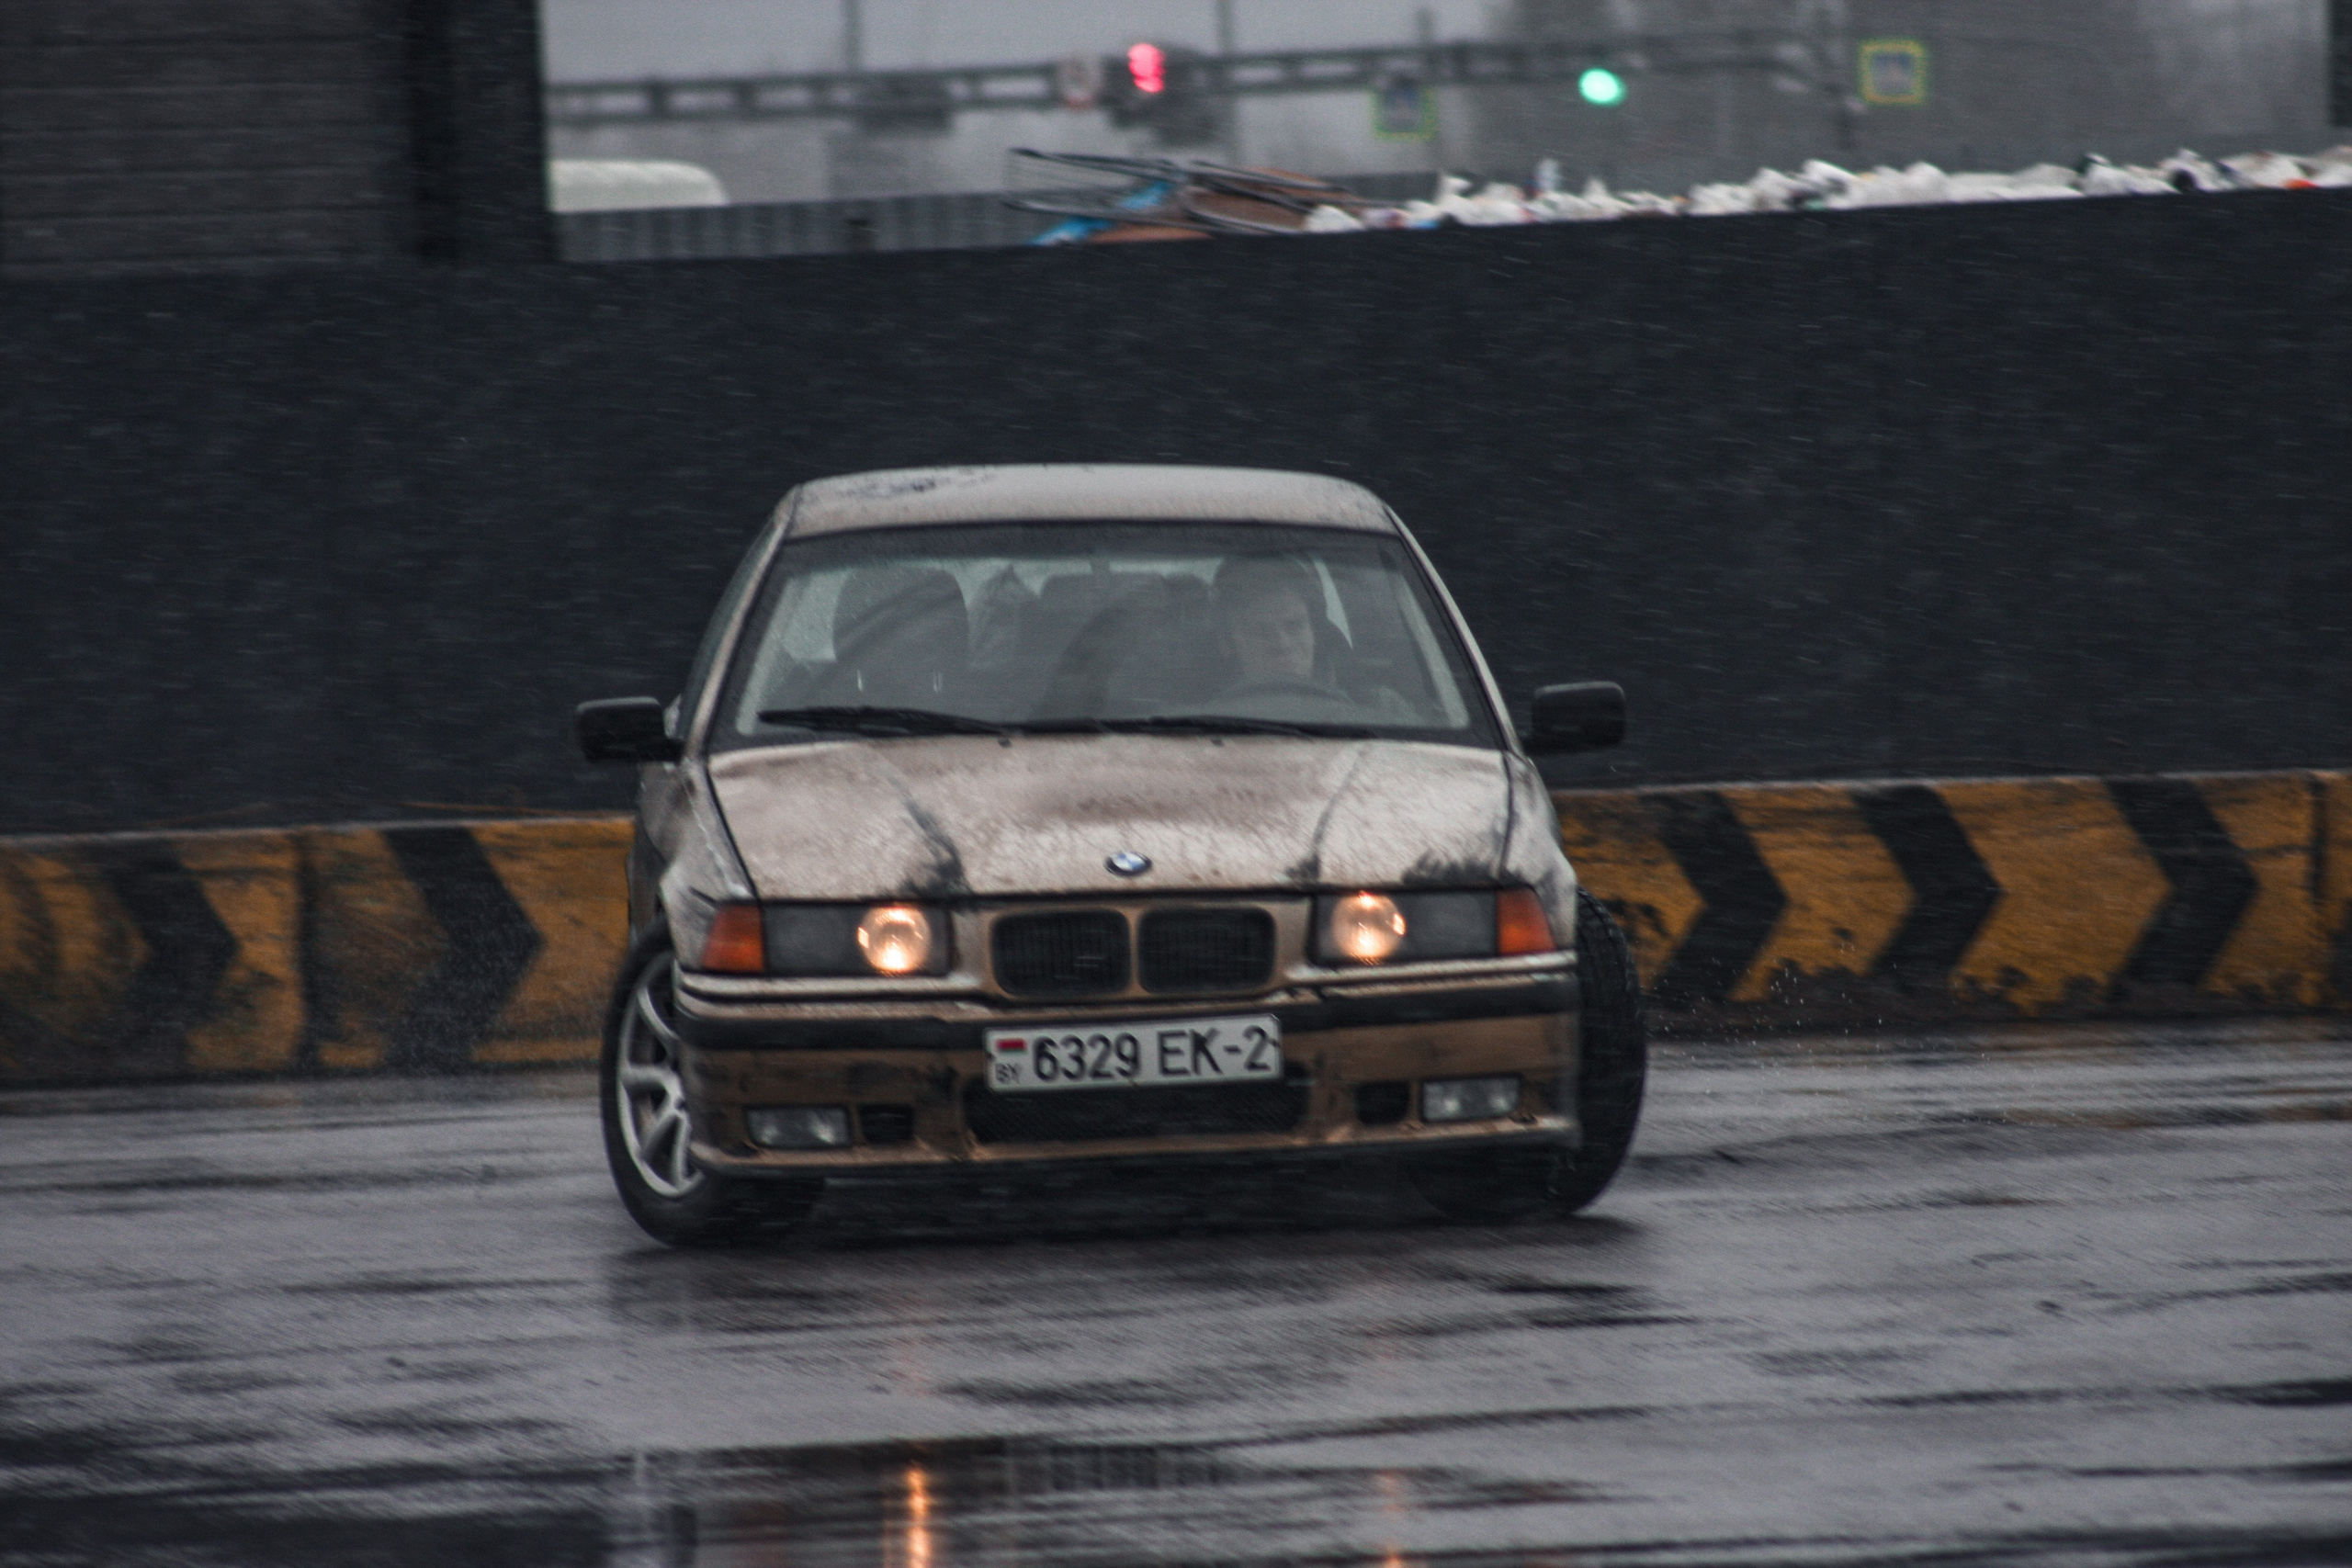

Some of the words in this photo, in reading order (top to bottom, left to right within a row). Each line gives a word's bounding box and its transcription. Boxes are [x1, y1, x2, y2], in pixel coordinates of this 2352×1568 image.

[1033, 1032, 1142, 1082] 6329
[1157, 1024, 1273, 1077] EK-2
[995, 1063, 1022, 1084] BY
